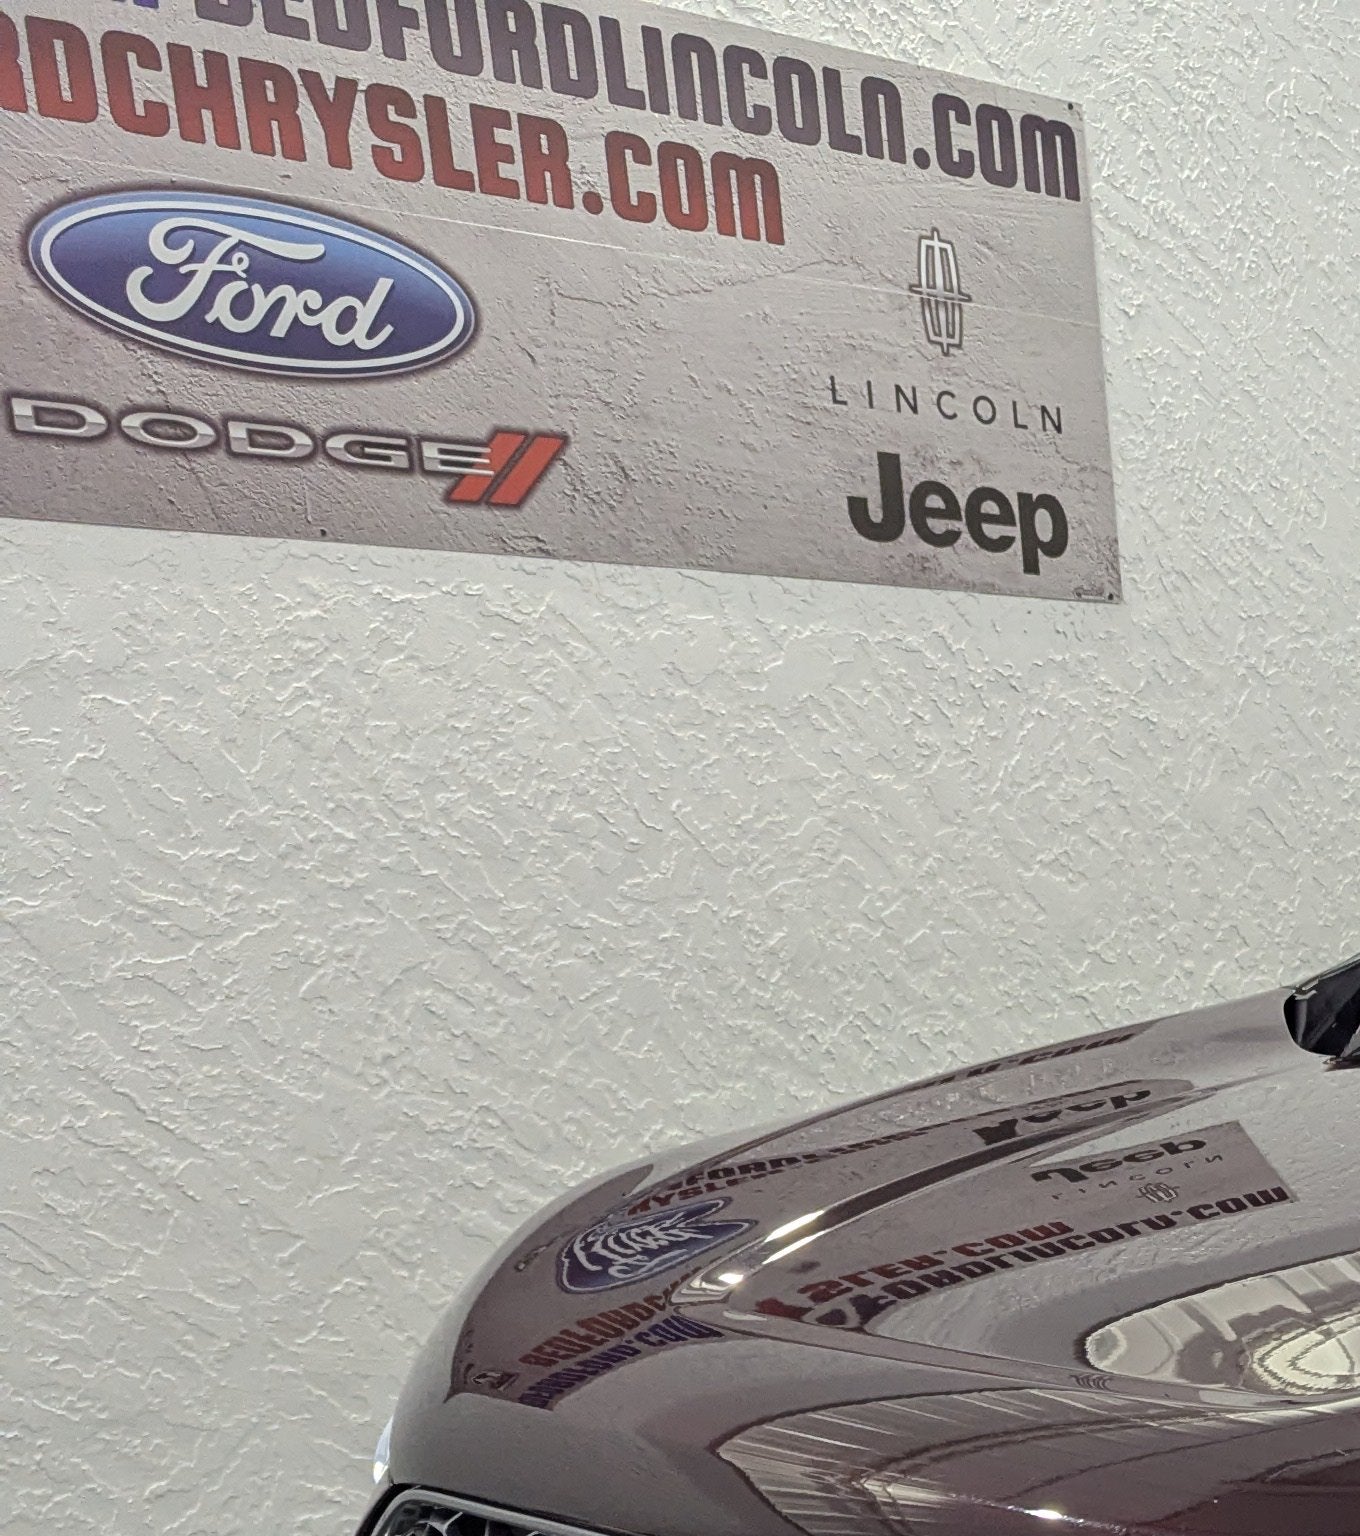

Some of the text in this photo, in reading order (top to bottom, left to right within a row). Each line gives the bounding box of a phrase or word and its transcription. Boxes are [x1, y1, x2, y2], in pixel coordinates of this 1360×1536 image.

[126, 217, 395, 350] Ford
[12, 398, 495, 477] DODGE
[829, 375, 1063, 434] LINCOLN
[847, 451, 1069, 576] Jeep
